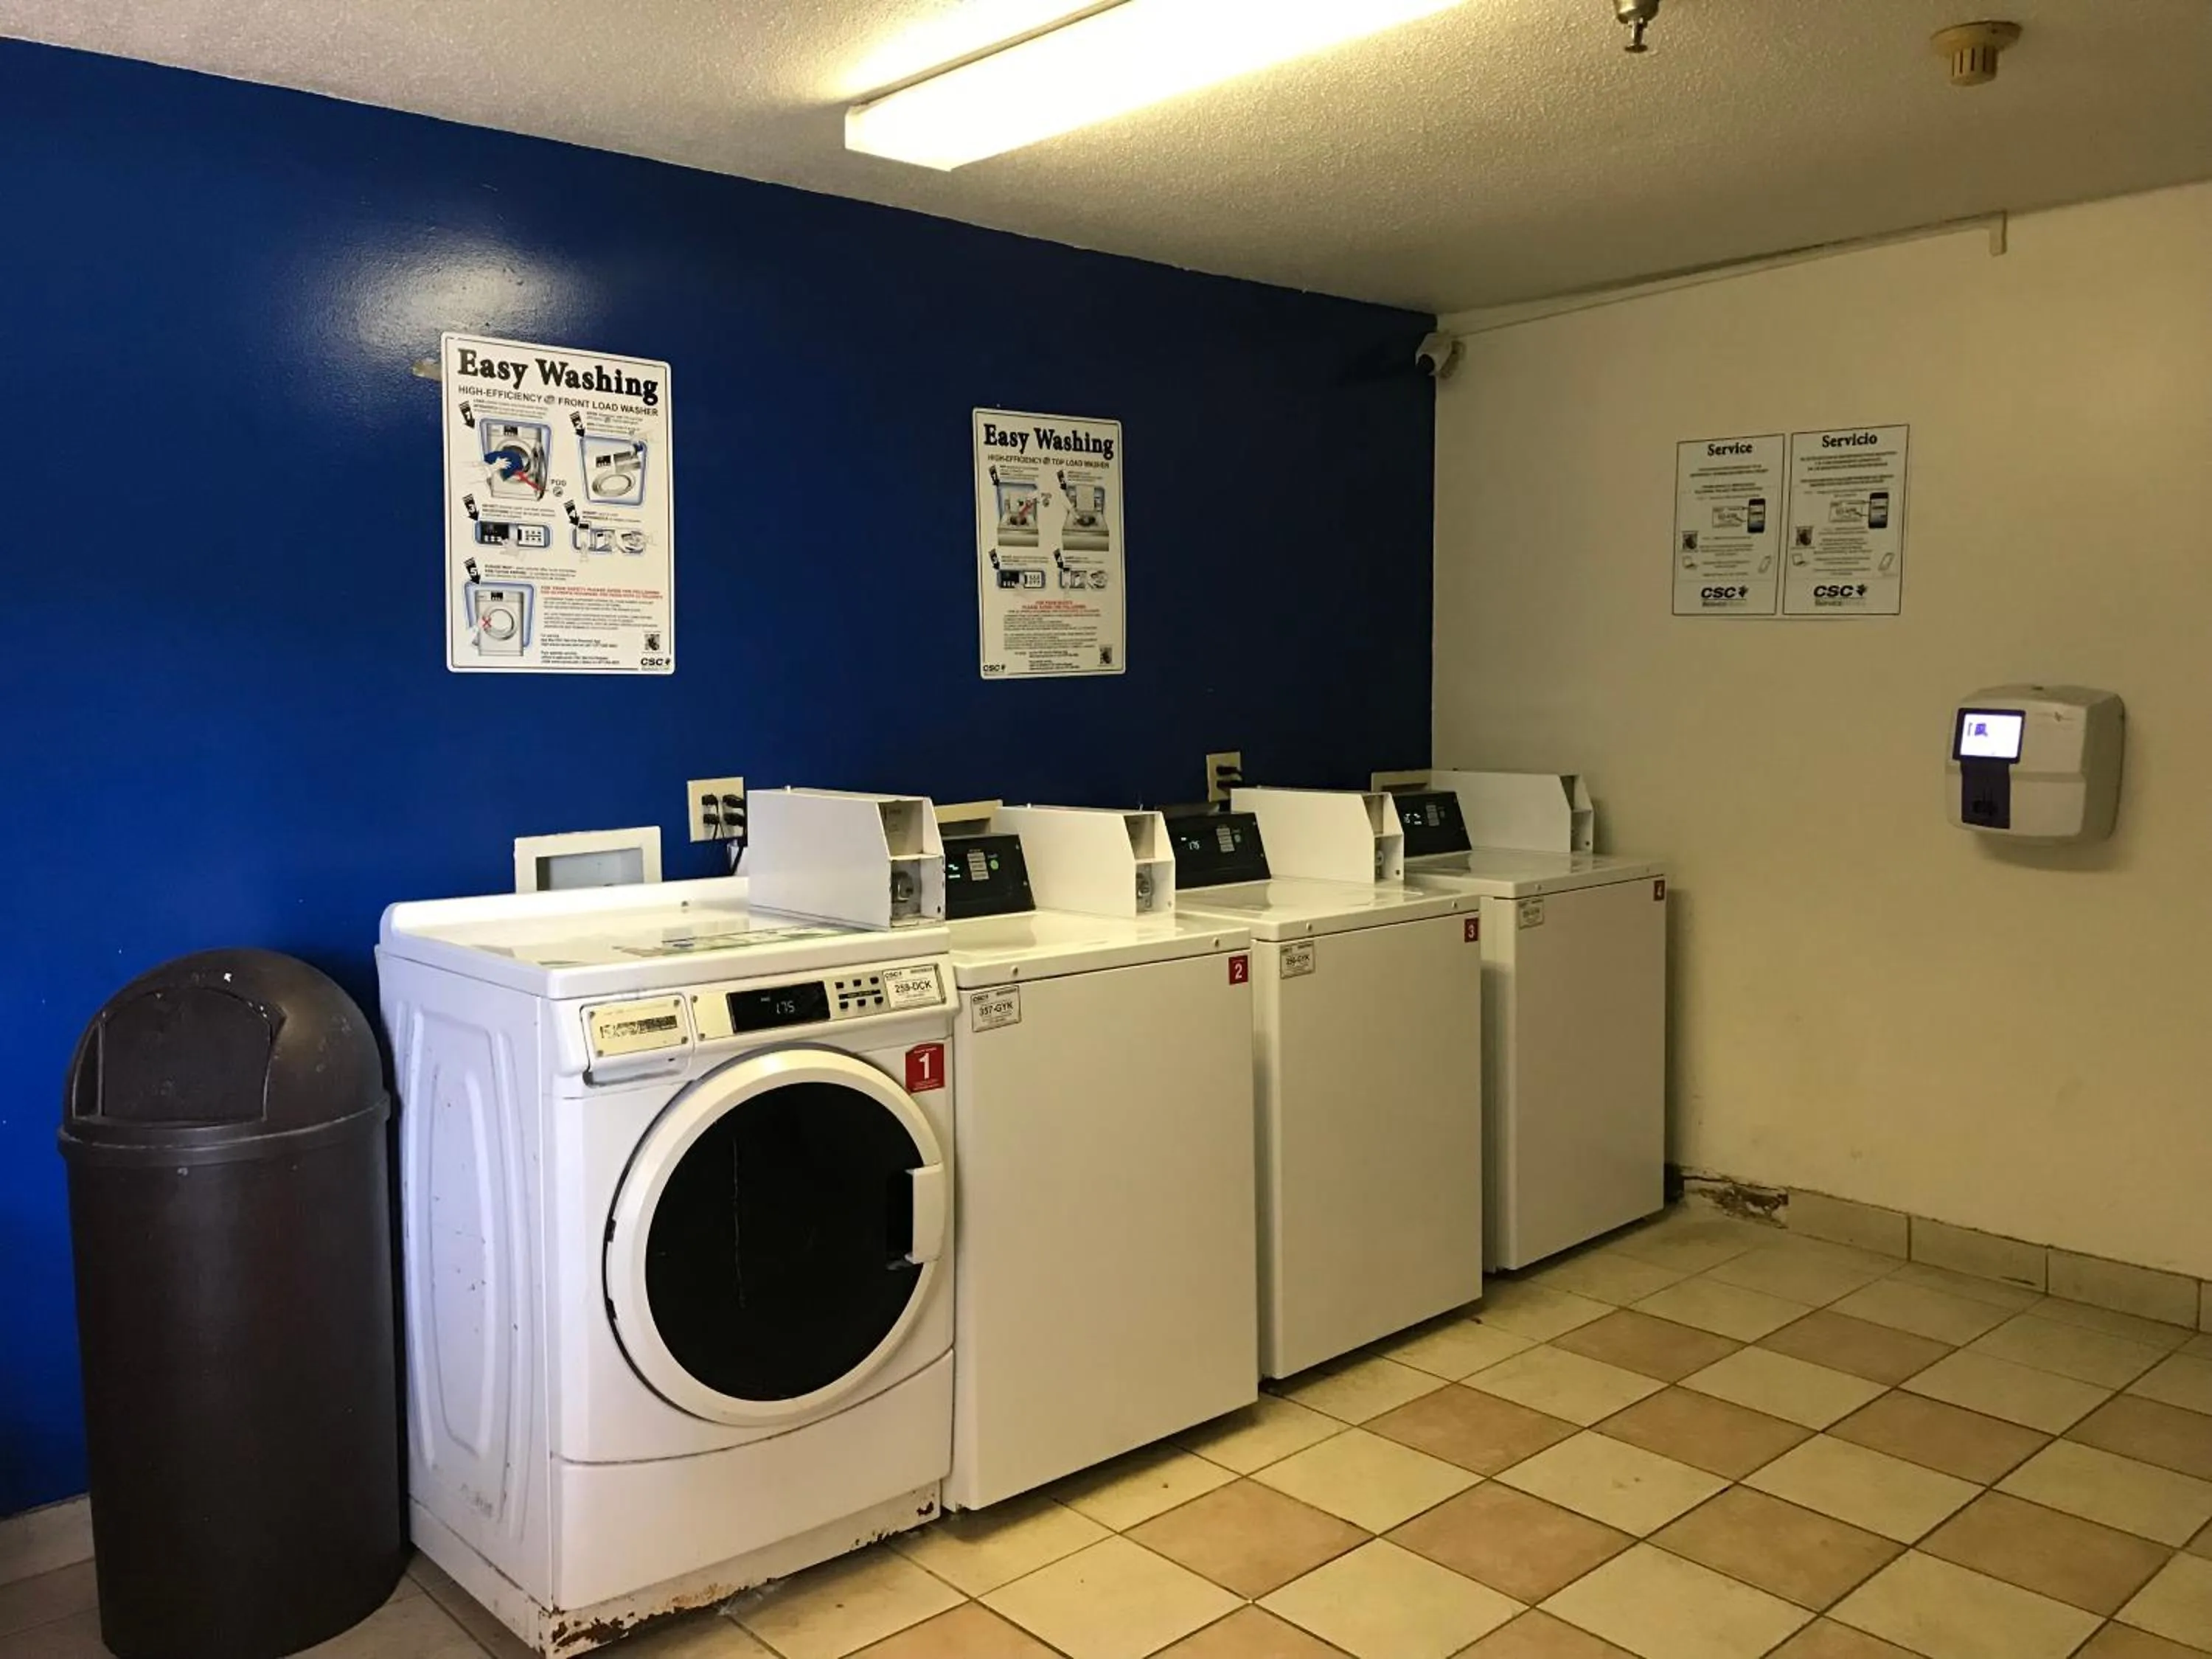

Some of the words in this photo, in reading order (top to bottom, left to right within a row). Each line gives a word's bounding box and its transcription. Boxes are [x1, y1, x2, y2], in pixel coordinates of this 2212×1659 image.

[458, 348, 528, 389] Easy
[535, 358, 658, 406] Washing
[458, 386, 543, 403] HIGH-EFFICIENCY
[558, 397, 590, 410] FRONT
[592, 400, 618, 412] LOAD
[621, 404, 658, 417] WASHER
[984, 423, 1029, 454] Easy
[1034, 427, 1114, 460] Washing
[1822, 433, 1878, 448] Servicio
[1707, 442, 1753, 456] Service
[1066, 459, 1083, 467] LOAD
[1701, 587, 1736, 599] CSC
[1813, 585, 1855, 598] CSC
[641, 657, 664, 666] CSC
[1468, 924, 1475, 939] 3
[1235, 963, 1242, 979] 2
[919, 1052, 929, 1079] 1
